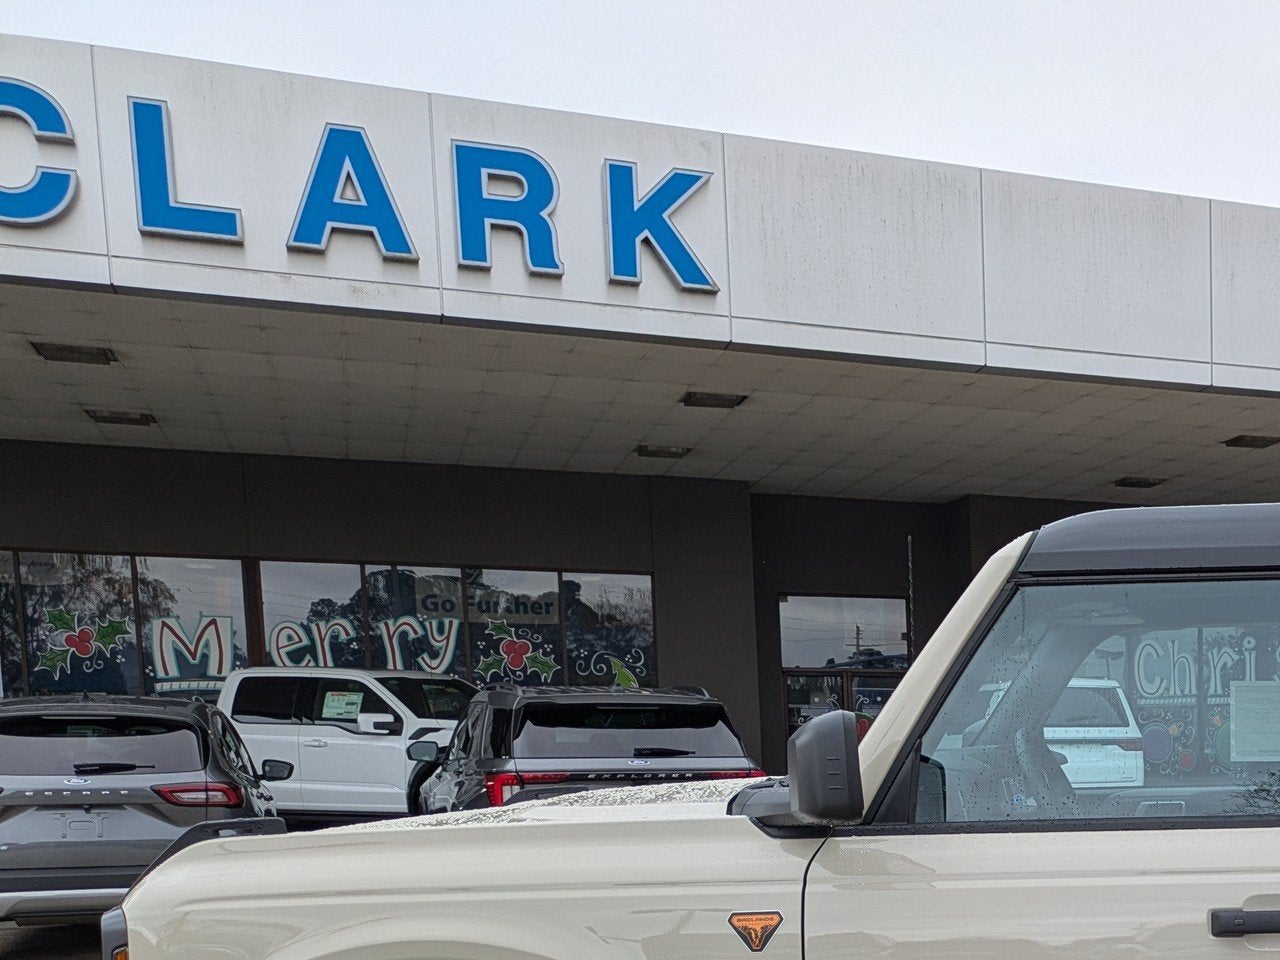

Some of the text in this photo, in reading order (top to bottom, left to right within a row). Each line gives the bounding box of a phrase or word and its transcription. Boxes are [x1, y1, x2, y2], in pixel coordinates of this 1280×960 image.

[0, 76, 720, 293] CLARK
[421, 594, 554, 615] Go Further
[151, 613, 461, 680] Merry
